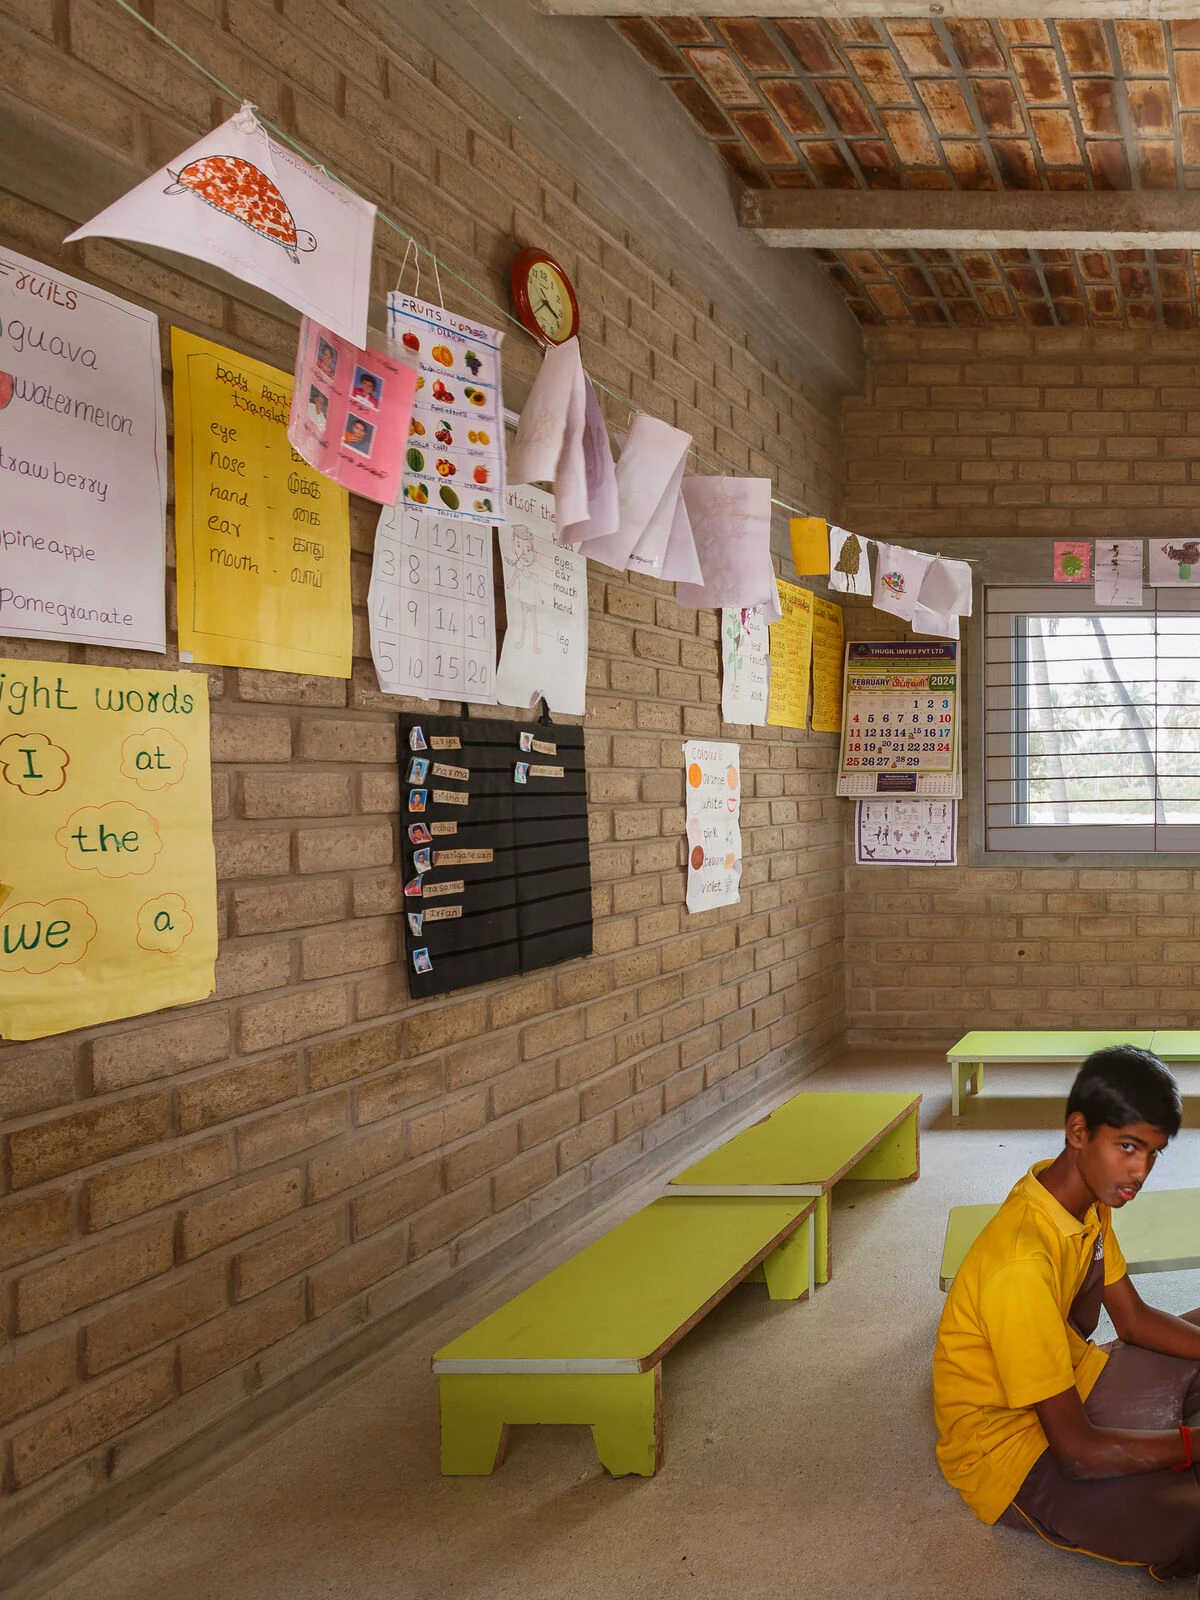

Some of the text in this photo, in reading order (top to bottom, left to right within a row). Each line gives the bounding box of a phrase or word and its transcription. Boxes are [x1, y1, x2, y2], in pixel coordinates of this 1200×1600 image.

[402, 298, 442, 321] FRUITS
[8, 320, 98, 370] guava
[216, 363, 292, 406] body Part
[14, 376, 134, 436] watermelon
[210, 421, 237, 443] eye
[0, 446, 108, 502] trawberry
[209, 450, 246, 477] nose
[209, 482, 249, 508] hand
[207, 515, 241, 538] ear
[409, 516, 419, 540] 7
[432, 523, 460, 555] 12
[466, 533, 485, 558] 17
[2, 530, 96, 562] pineapple
[380, 549, 486, 599] 3 8 13 18
[554, 555, 574, 571] eyes
[555, 569, 571, 583] ear
[553, 582, 578, 599] mouth
[378, 596, 486, 640] 4 9 14 19
[553, 597, 574, 616] hand
[556, 630, 570, 655] leg
[378, 640, 488, 685] 5 10 15 20
[0, 673, 195, 715] ight words
[852, 678, 890, 686] FEBRUARY
[931, 676, 955, 687] 2024
[939, 714, 952, 723] 10
[849, 728, 861, 738] 11
[864, 728, 877, 738] 12
[879, 728, 892, 738] 13
[894, 728, 906, 738] 14
[924, 728, 936, 738] 16
[939, 728, 951, 738] 17
[848, 743, 861, 752] 18
[863, 743, 876, 752] 19
[892, 743, 905, 752] 21
[907, 743, 921, 752] 22
[922, 743, 936, 752] 23
[936, 743, 950, 752] 24
[18, 745, 172, 779] I at
[846, 757, 860, 766] 25
[861, 757, 875, 766] 26
[876, 757, 890, 766] 27
[906, 757, 920, 766] 29
[71, 824, 140, 853] the
[3, 910, 175, 954] we a
